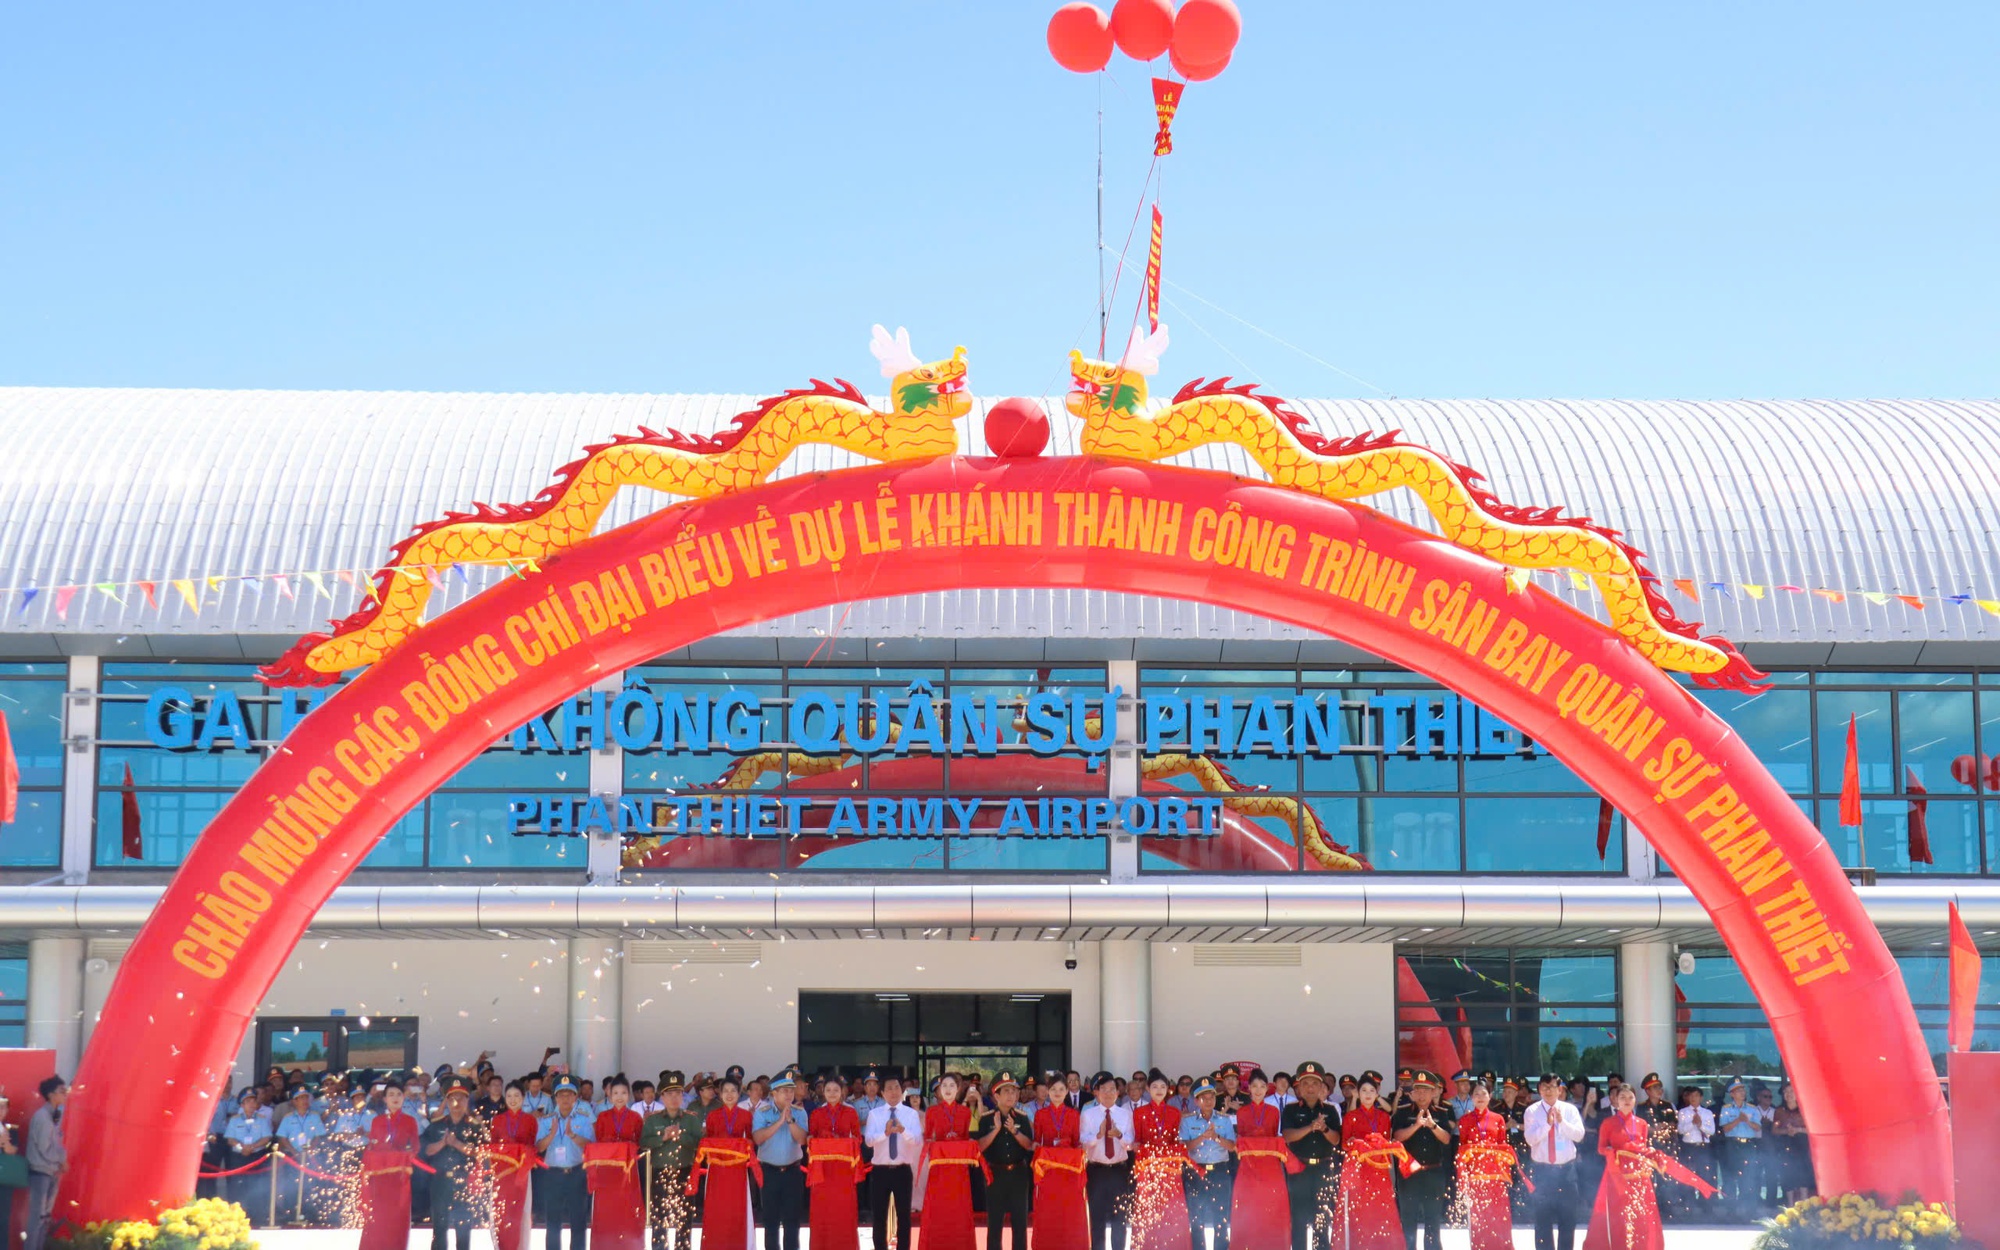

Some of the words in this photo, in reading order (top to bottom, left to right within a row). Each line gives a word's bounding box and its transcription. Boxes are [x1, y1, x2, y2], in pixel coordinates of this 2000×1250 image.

[146, 686, 252, 750] GA
[790, 678, 998, 754] QUÂN
[1026, 684, 1122, 769] SỰ
[1146, 694, 1340, 754] PHAN
[1369, 695, 1548, 755] THIE
[173, 871, 272, 979] CHÀO
[239, 766, 353, 885] MỪNG
[335, 706, 421, 787] CÁC
[400, 634, 519, 734] ĐỒNG
[505, 585, 582, 667] CHÍ
[570, 571, 647, 635] ĐẠI
[640, 524, 734, 609] BIỂU
[734, 506, 788, 579] VỀ
[790, 500, 847, 572] DỰ
[854, 482, 903, 555] LỄ
[911, 483, 1043, 547] KHÁNH
[1054, 487, 1182, 555] THÀNH
[1189, 502, 1296, 579] CÔNG
[1300, 535, 1417, 618] TRÌNH
[1409, 580, 1500, 656] SÂN
[1483, 618, 1573, 695] BAY
[1557, 664, 1667, 762] QUÂN
[1643, 737, 1721, 804] SỰ
[1684, 783, 1791, 895] PHAN
[1755, 880, 1851, 985] THIẾT
[507, 796, 652, 834] PHAN
[676, 796, 811, 836] THIET
[826, 797, 983, 836] ARMY
[1000, 797, 1223, 837] AIRPORT
